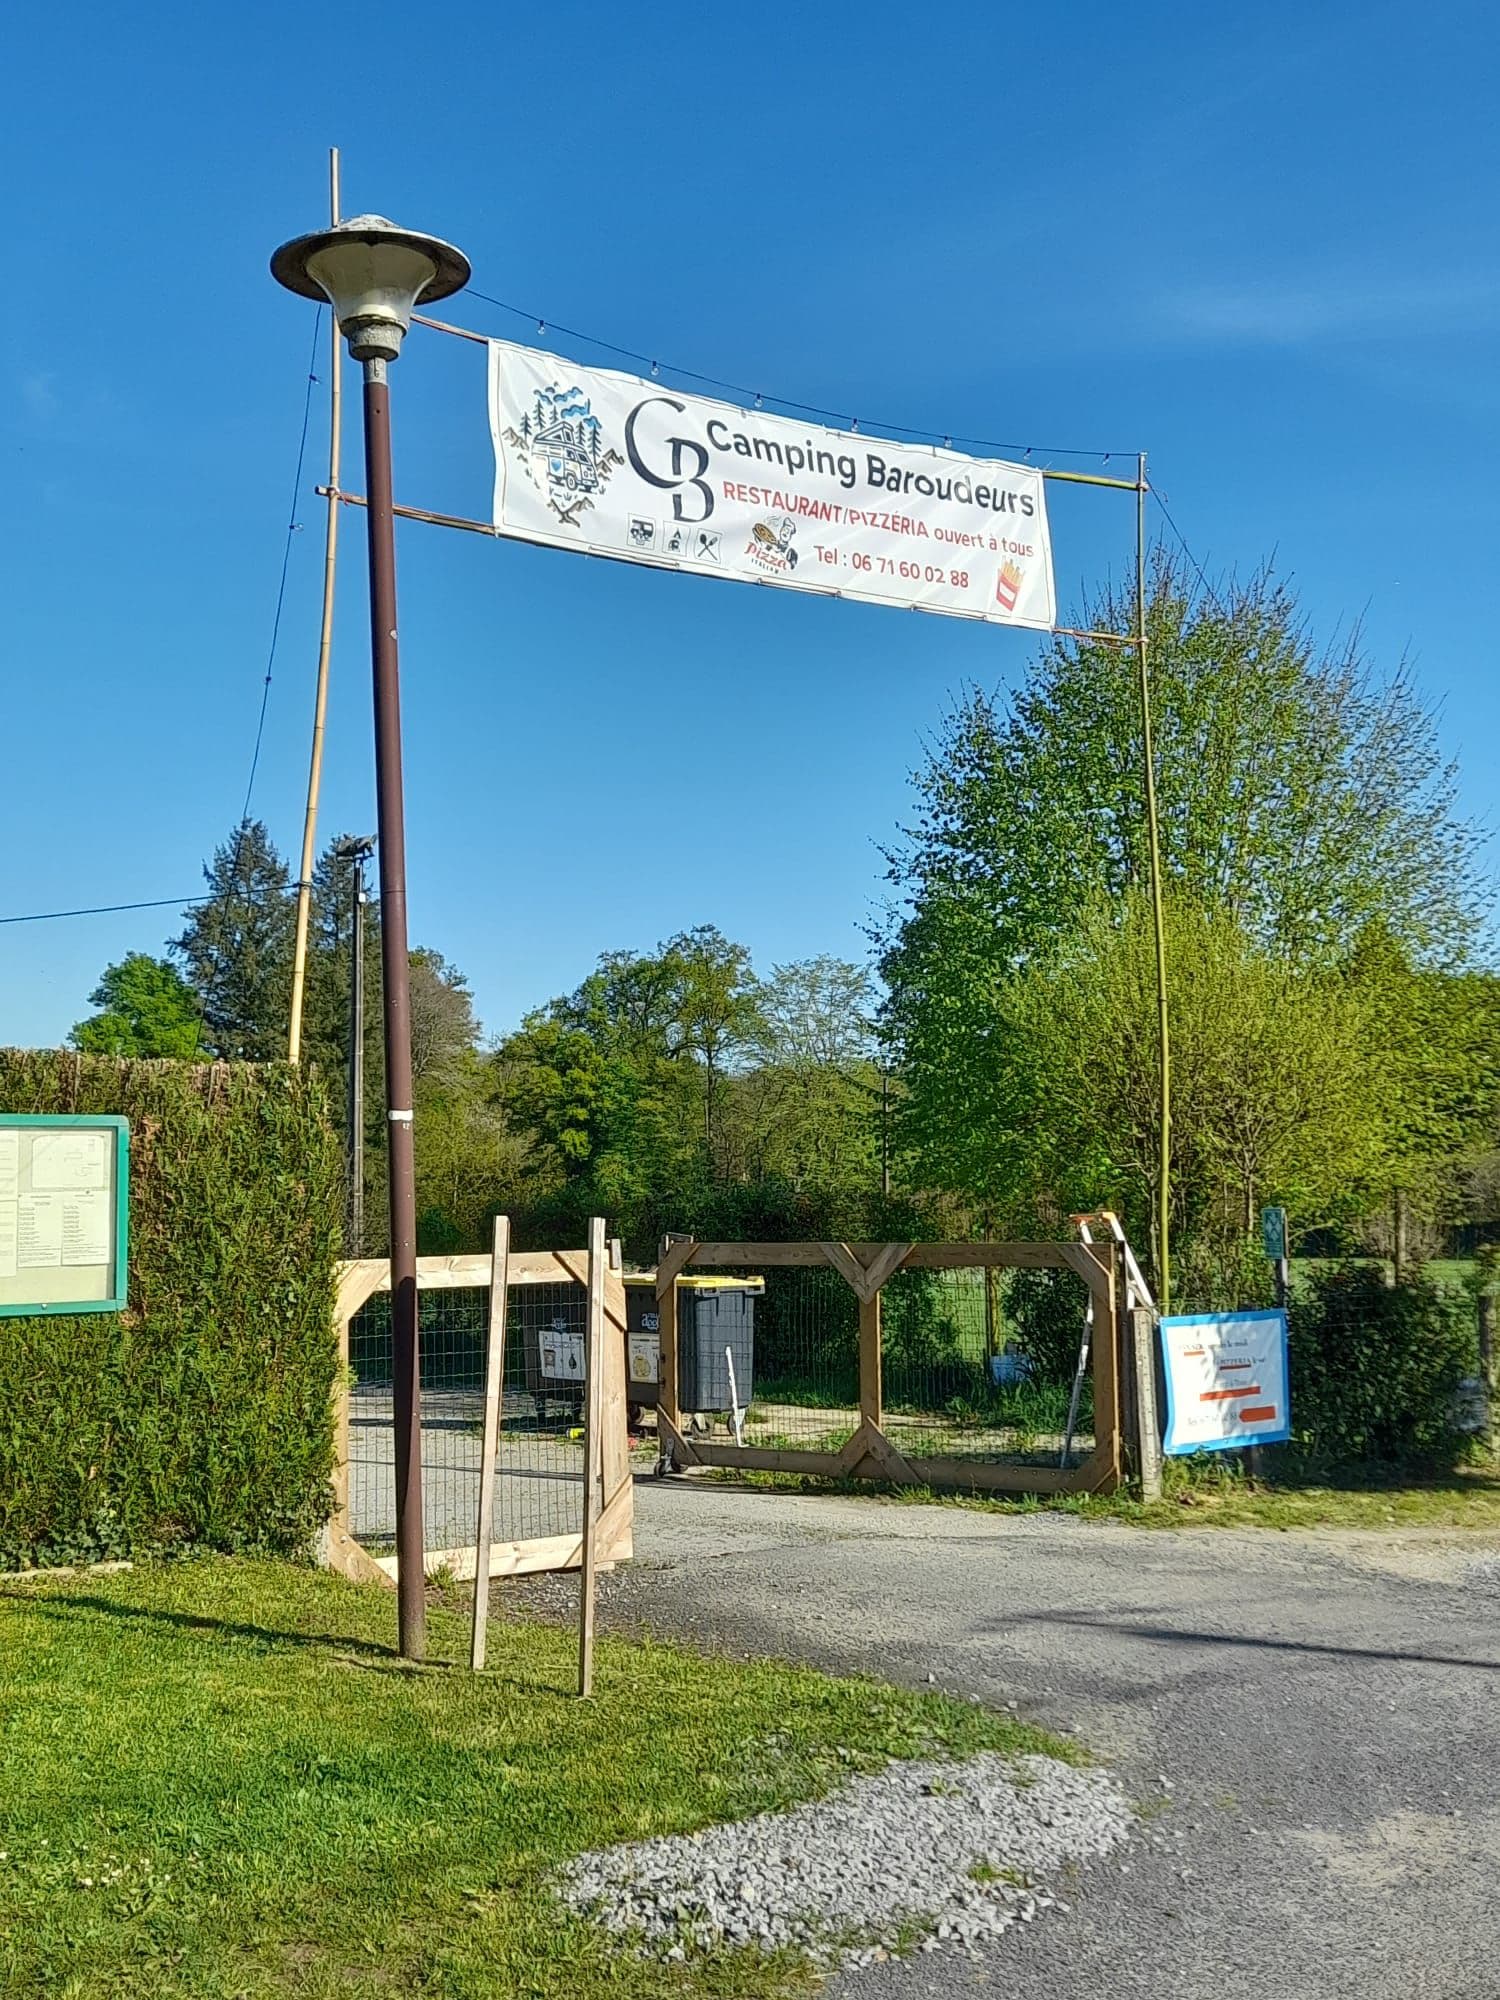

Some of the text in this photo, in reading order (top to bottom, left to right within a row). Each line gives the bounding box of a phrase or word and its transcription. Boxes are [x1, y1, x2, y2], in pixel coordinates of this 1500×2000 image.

[706, 419, 1034, 517] Camping Baroudeurs
[933, 526, 985, 549] ouvert
[989, 533, 998, 551] à
[1002, 536, 1035, 558] tous
[813, 544, 838, 566] Tel
[851, 551, 873, 572] 06
[876, 557, 895, 575] 71
[898, 560, 921, 580] 60
[924, 565, 946, 584] 02
[950, 569, 970, 588] 88
